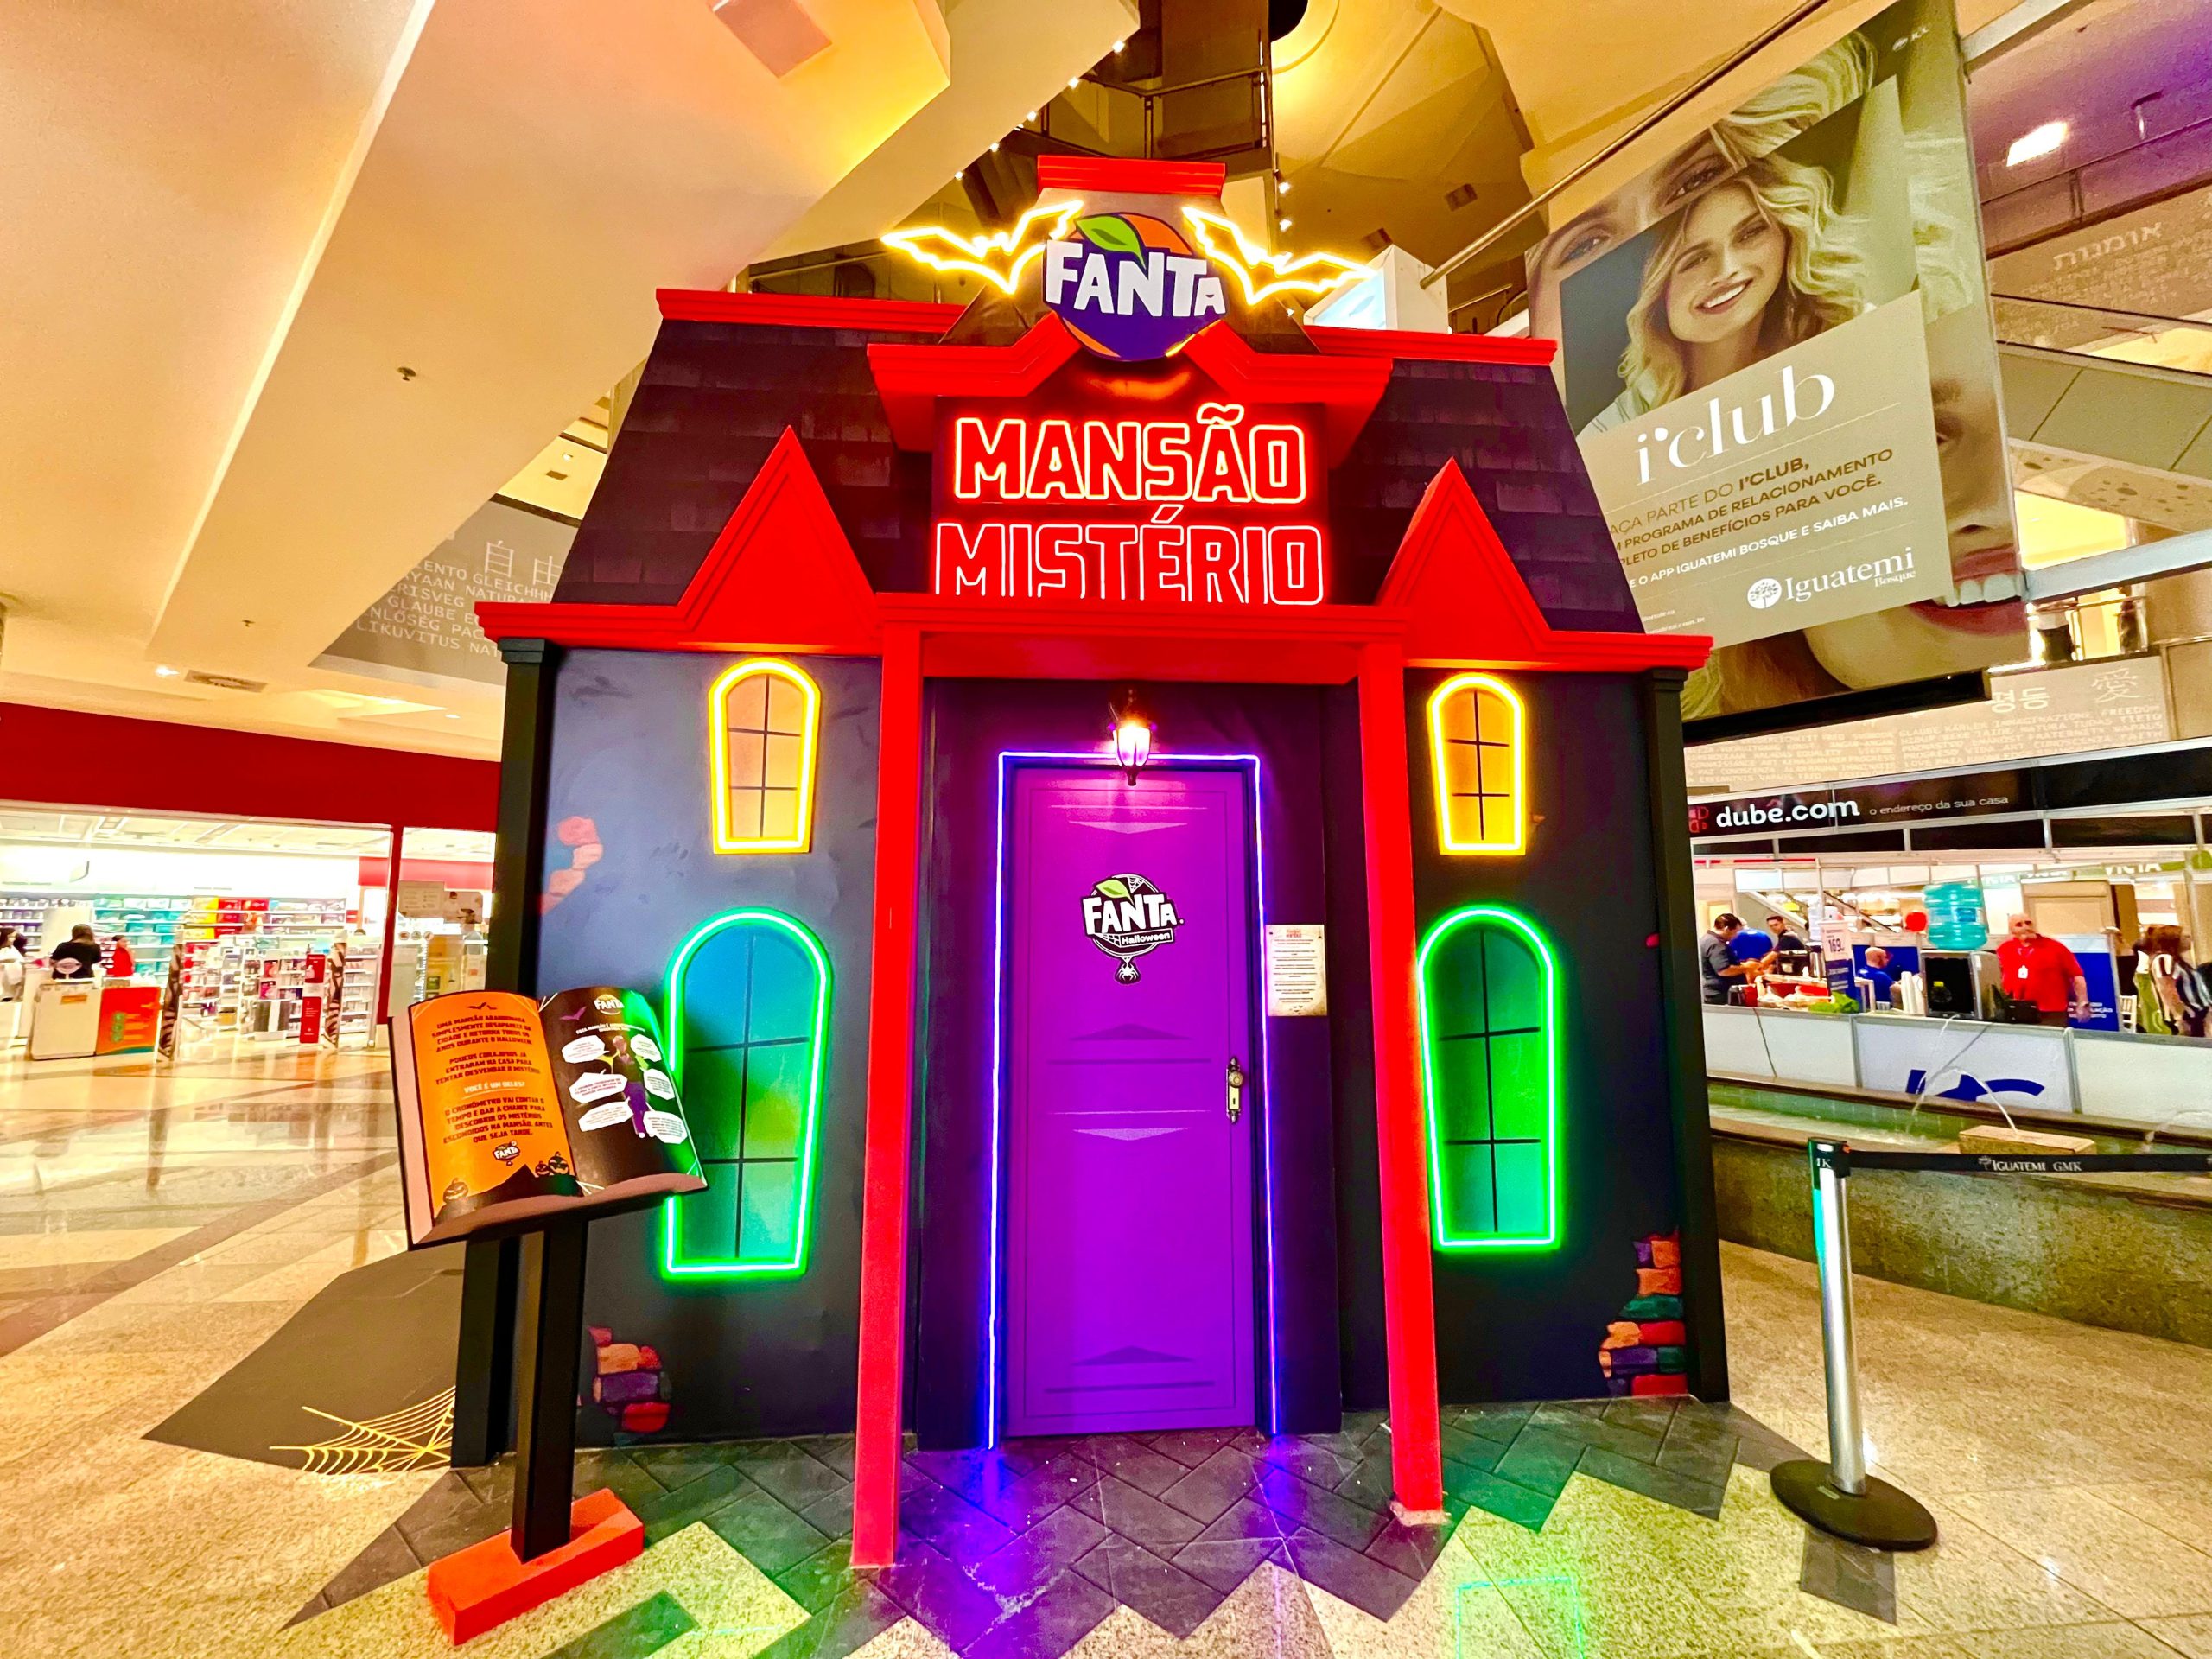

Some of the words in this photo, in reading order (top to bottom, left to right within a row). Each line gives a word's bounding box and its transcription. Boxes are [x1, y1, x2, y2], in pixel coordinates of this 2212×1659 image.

[1046, 239, 1225, 316] FANTA
[955, 403, 1306, 504] MANSÃO
[1610, 516, 1642, 535] AÇA
[1647, 494, 1699, 523] PARTE
[1704, 483, 1733, 504] DO
[1624, 514, 1704, 548] PROGRAMA
[1708, 505, 1727, 520] DE
[1732, 448, 1893, 512] RELACIONAMENTO
[1620, 548, 1658, 565] PLETO
[1662, 540, 1680, 554] DE
[1683, 511, 1770, 547] BENEFÍCIOS
[1775, 495, 1821, 517] PARA
[1824, 473, 1882, 500] VOCÊ.
[935, 504, 1324, 605] MISTÉRIO
[1638, 575, 1648, 585] O
[1651, 567, 1675, 582] APP
[1676, 548, 1736, 574] IGUATEMI
[1739, 528, 1798, 556] BOSQUE
[1802, 525, 1809, 536] E
[1813, 511, 1859, 532] SAIBA
[1862, 497, 1909, 518] MAIS.
[416, 559, 467, 581] ENTO
[1784, 546, 1915, 603] Iguatemi
[1873, 570, 1916, 588] Bosque
[387, 594, 456, 620] GLAUBE
[390, 582, 464, 607] RISVEG
[451, 624, 485, 640] PAC
[469, 642, 501, 658] NAT
[1716, 800, 1860, 828] dube.com
[1879, 804, 1933, 814] endereço
[1936, 800, 1950, 810] da
[1954, 798, 1976, 808] sua
[1979, 796, 2009, 806] casa
[1083, 893, 1178, 935] FANTA
[1122, 932, 1170, 945] Halloween
[1993, 1160, 2046, 1172] IGUATEMI
[2053, 1161, 2082, 1172] GMK
